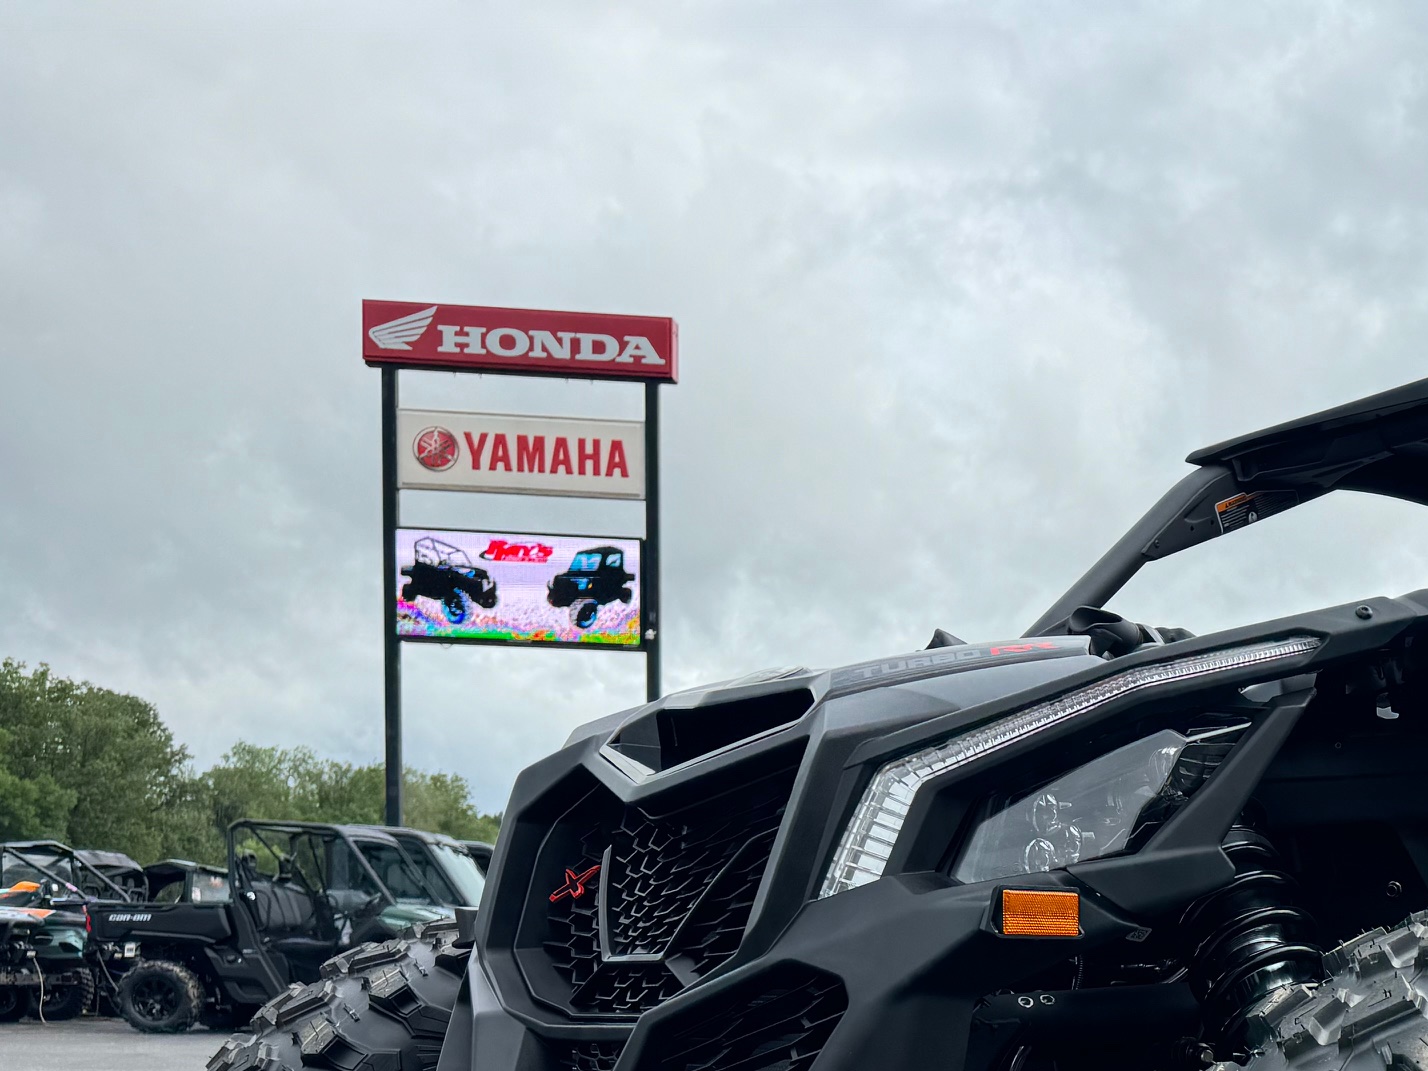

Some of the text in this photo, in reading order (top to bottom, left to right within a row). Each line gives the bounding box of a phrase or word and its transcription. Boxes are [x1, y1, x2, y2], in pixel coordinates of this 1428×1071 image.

[437, 324, 666, 366] HONDA
[463, 431, 630, 478] YAMAHA
[856, 650, 981, 678] TURBO
